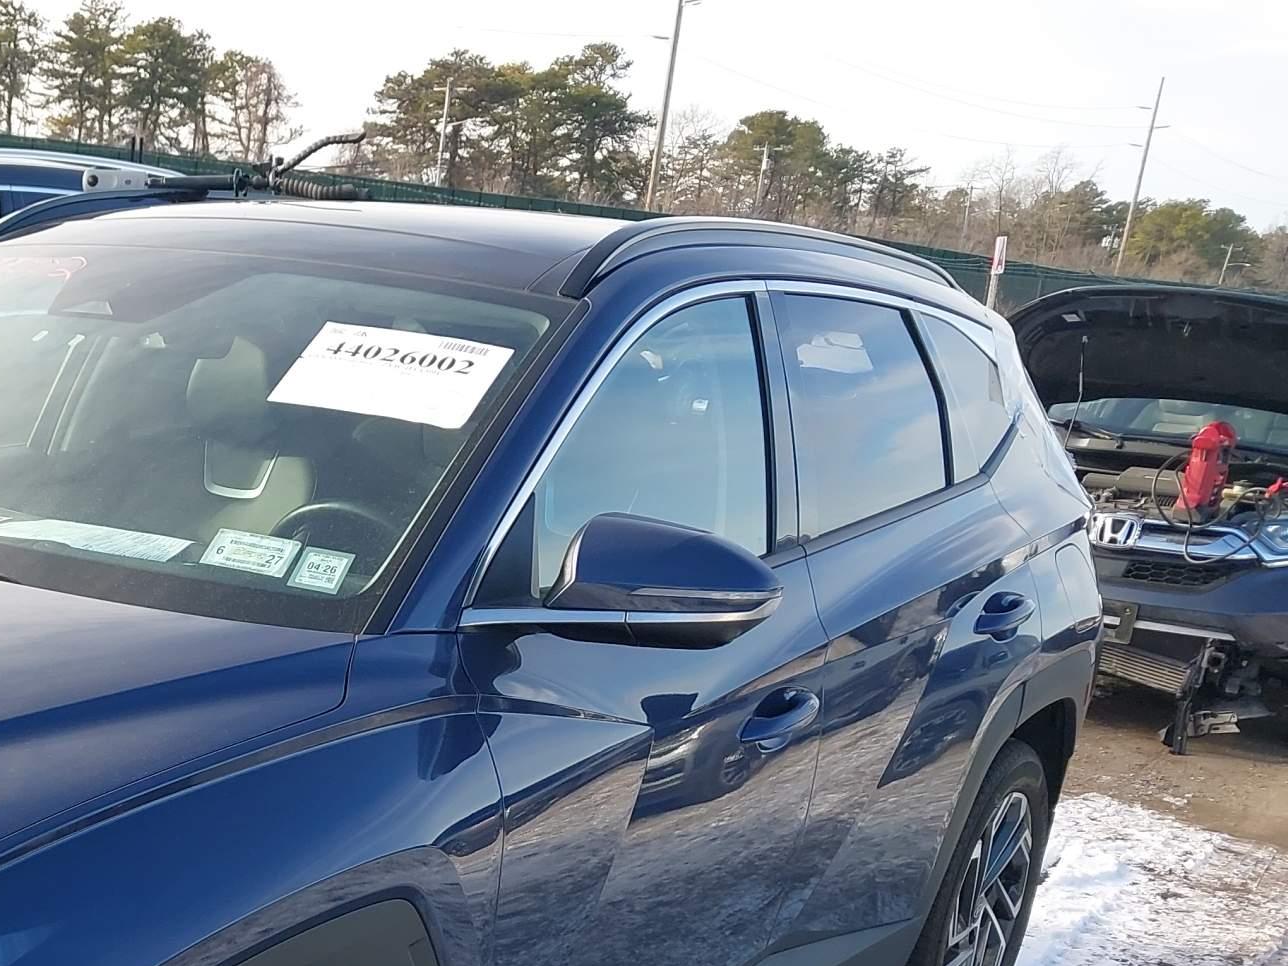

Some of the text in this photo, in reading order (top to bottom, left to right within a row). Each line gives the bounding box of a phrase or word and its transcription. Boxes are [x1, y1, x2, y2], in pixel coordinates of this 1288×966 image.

[325, 341, 475, 375] 44026002
[216, 545, 225, 555] 6
[264, 553, 285, 567] 27
